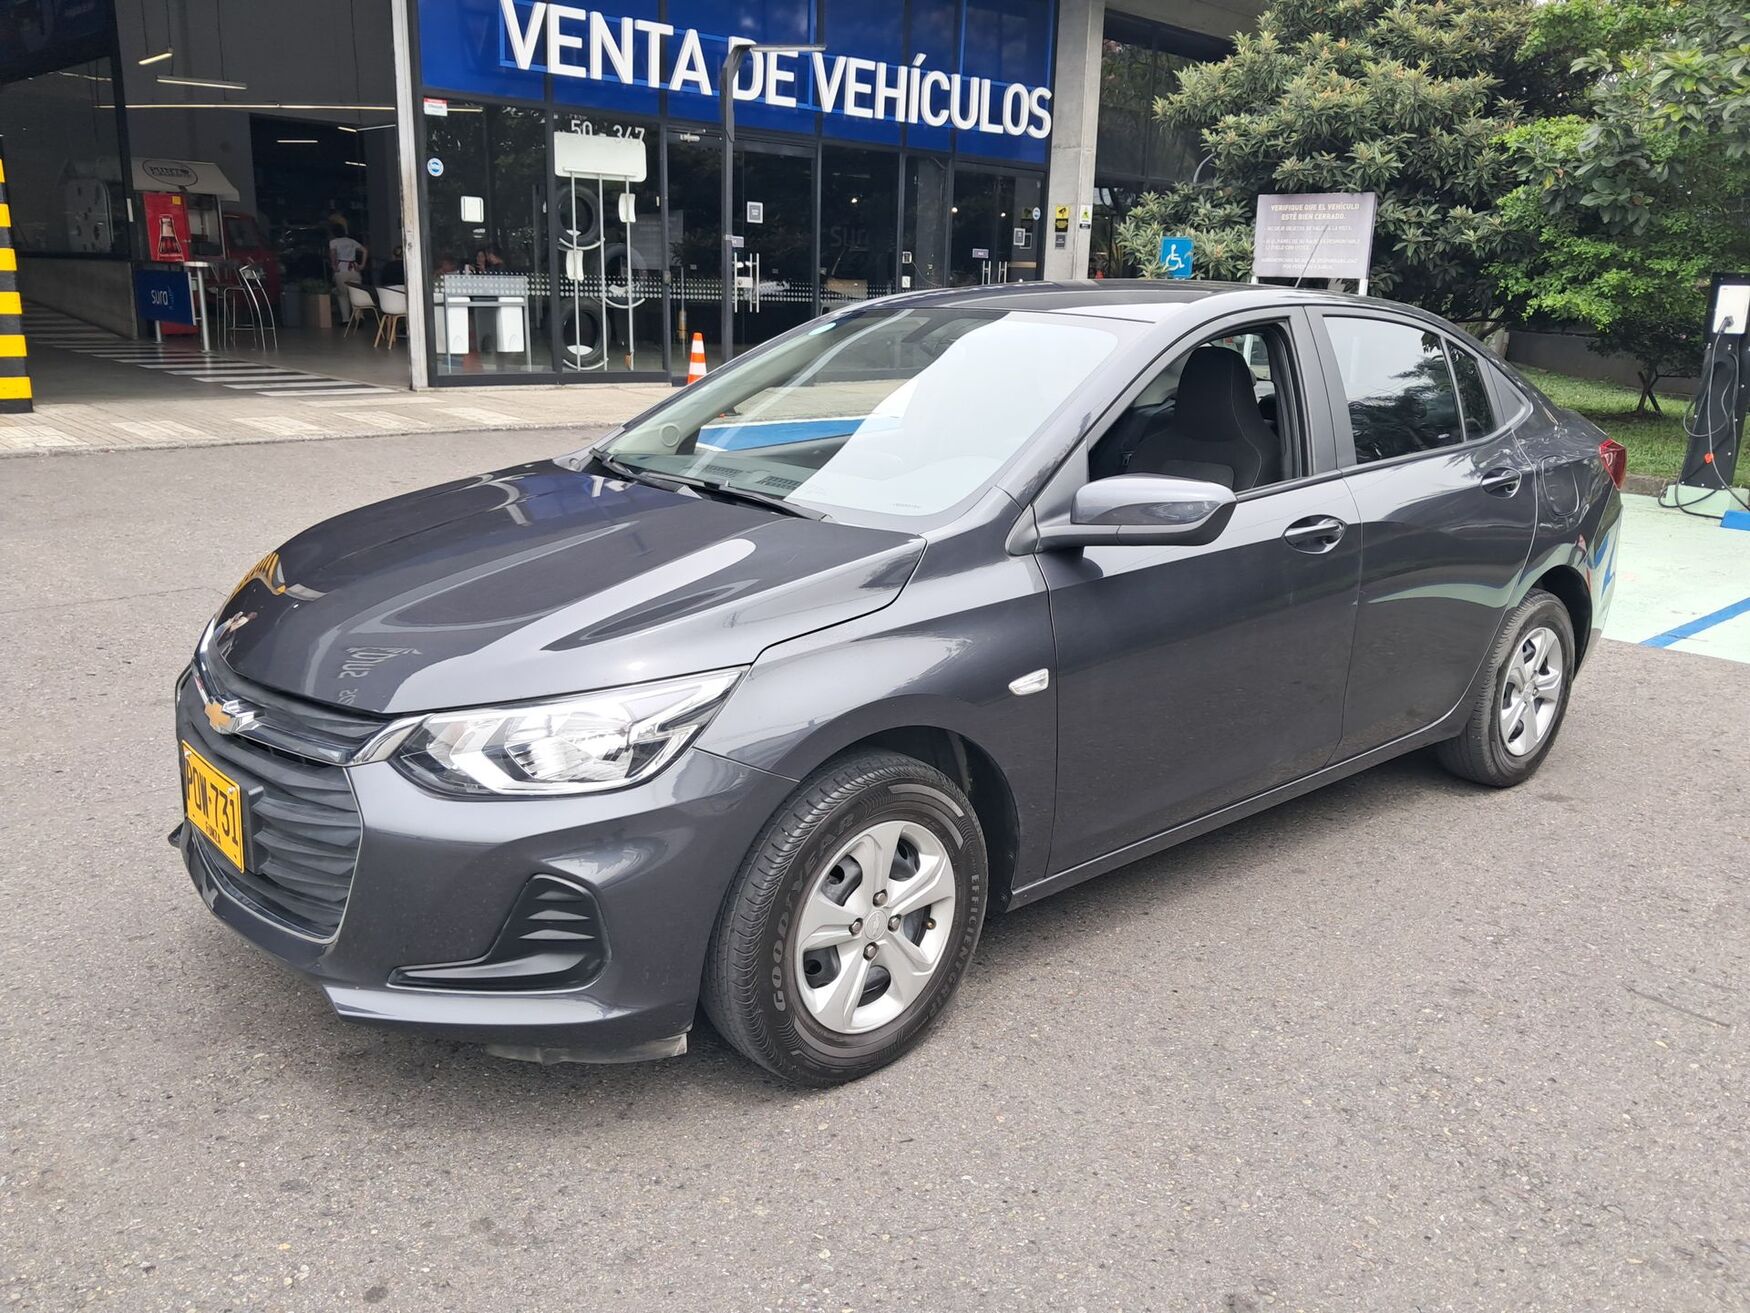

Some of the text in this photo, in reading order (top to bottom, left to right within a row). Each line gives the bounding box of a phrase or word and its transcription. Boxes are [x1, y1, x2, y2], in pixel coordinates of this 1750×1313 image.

[500, 0, 1052, 139] VENTA DE VEHÍCULOS
[1271, 204, 1303, 212] VERIFIQUE
[1304, 203, 1317, 211] QUE
[1327, 201, 1360, 211] VEHÍCULO
[1281, 211, 1297, 221] ESTÉ
[151, 289, 168, 306] sura
[771, 812, 855, 1012] GOODYEAR
